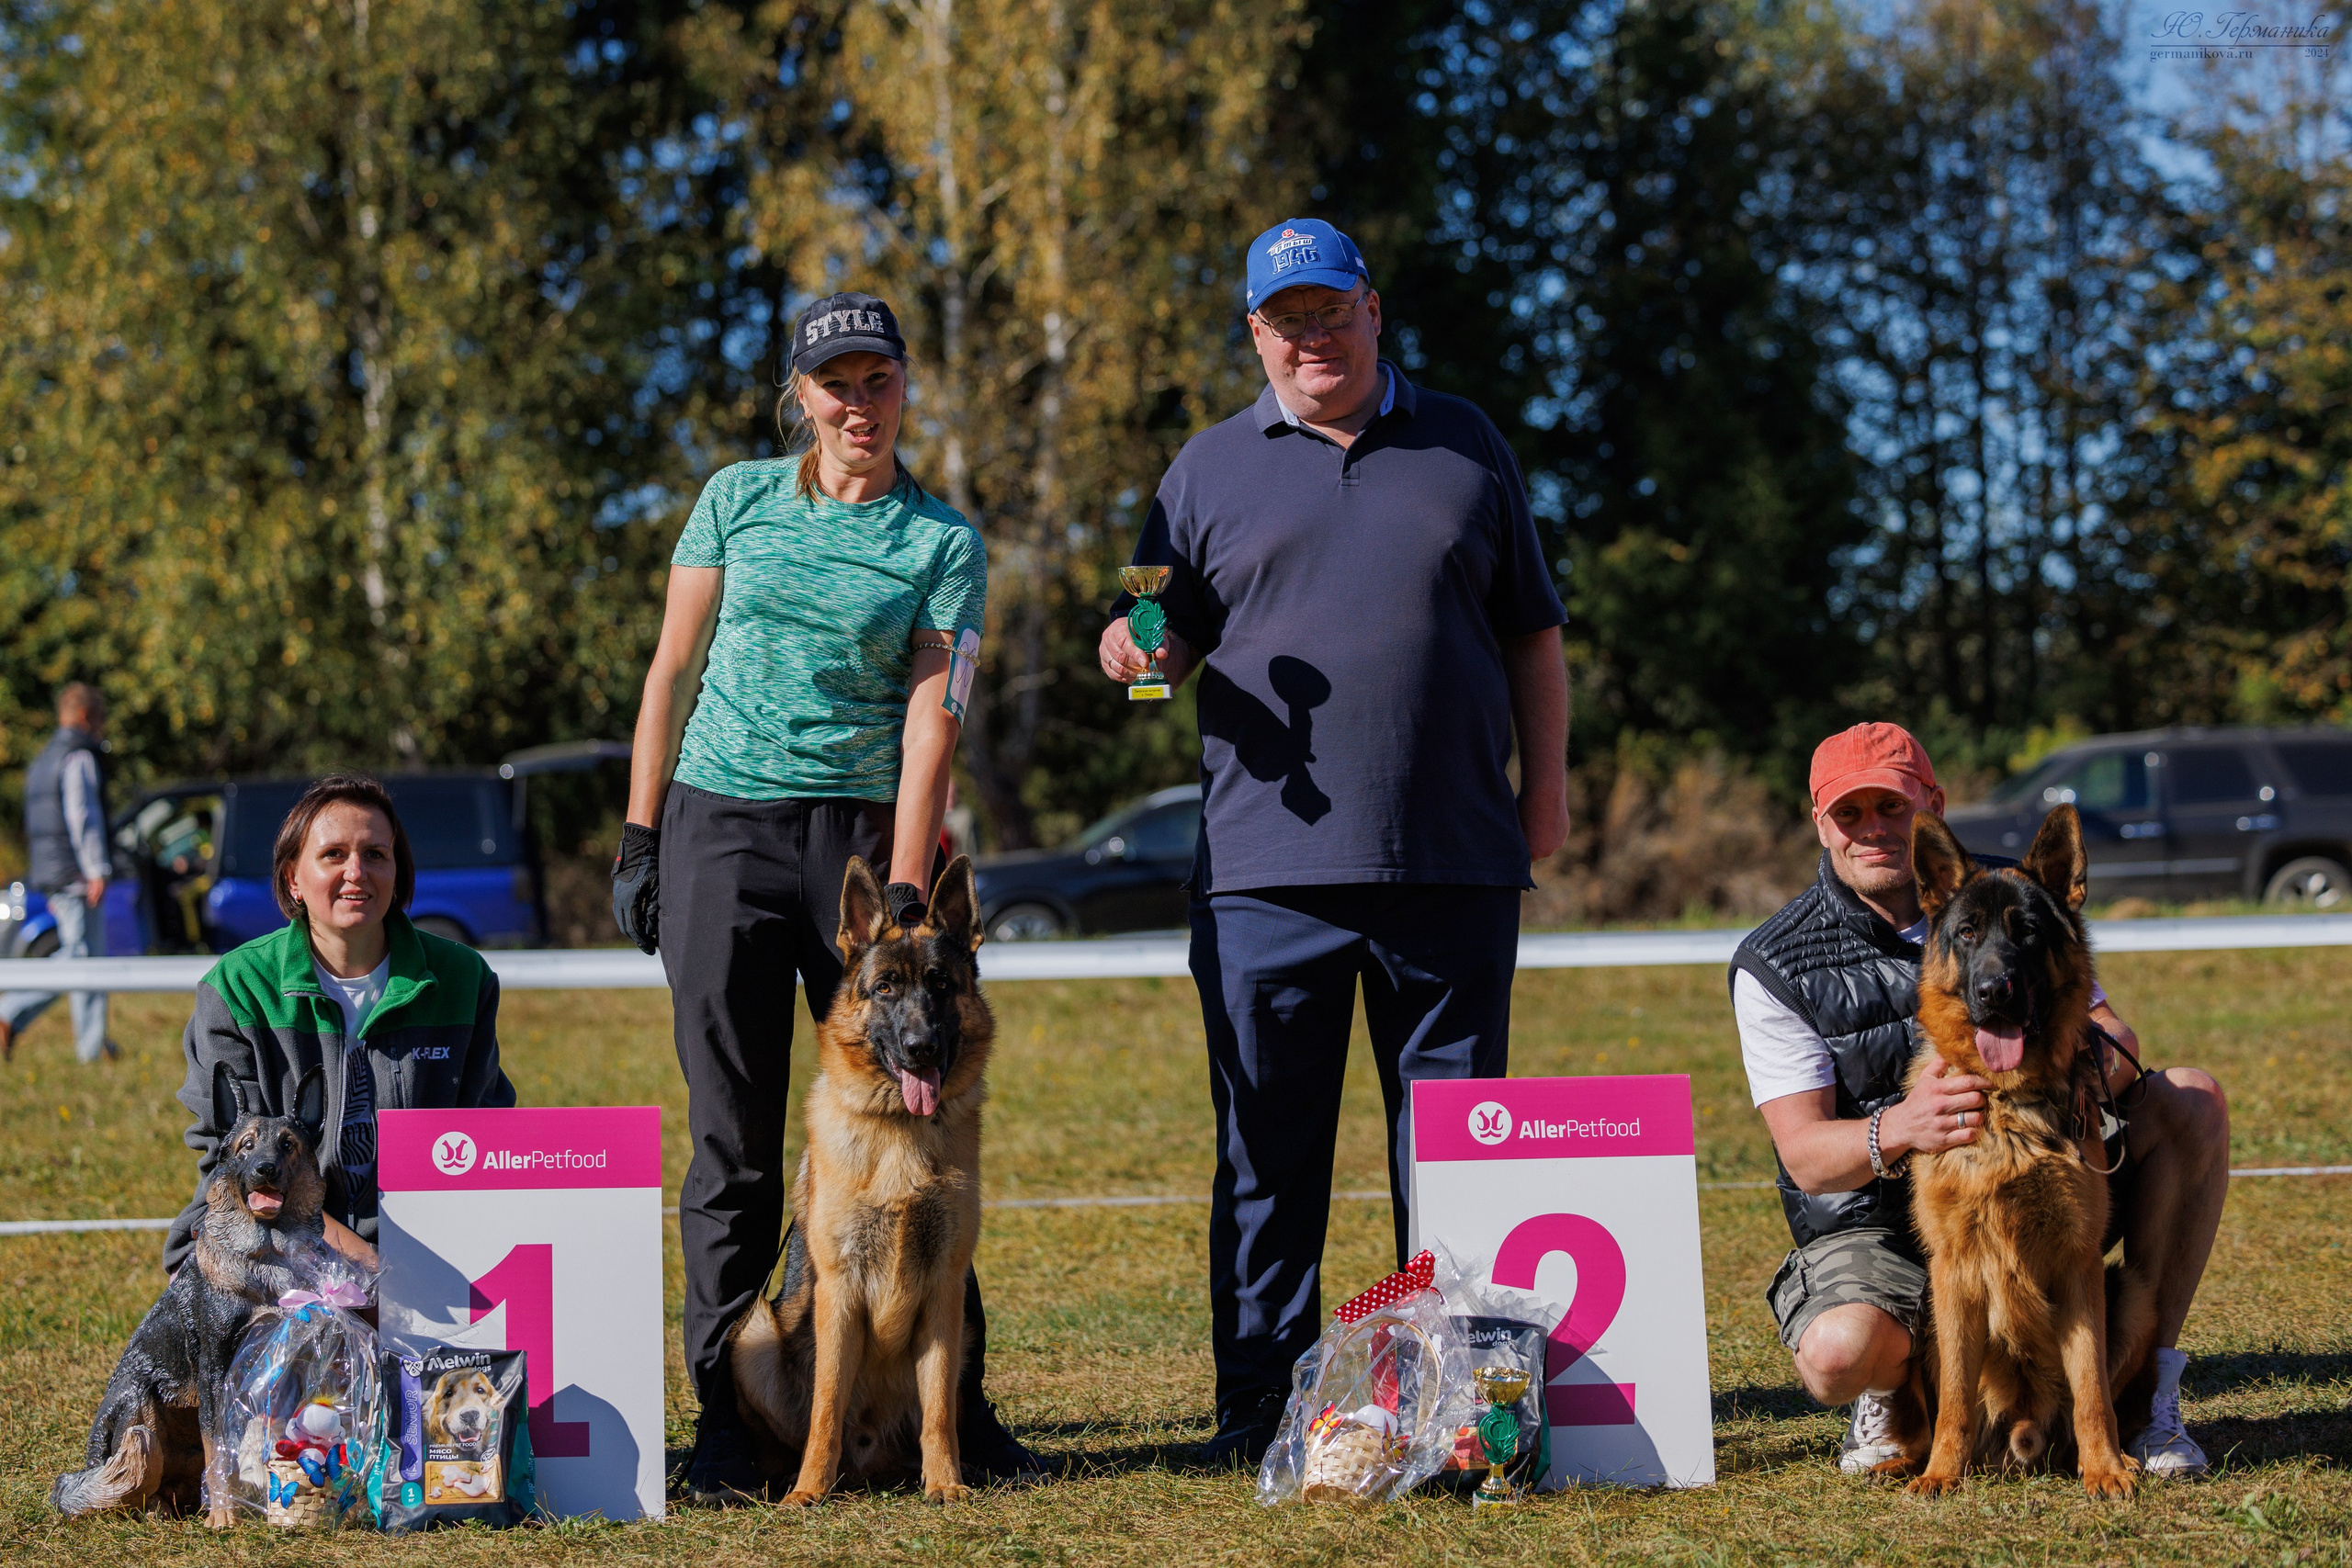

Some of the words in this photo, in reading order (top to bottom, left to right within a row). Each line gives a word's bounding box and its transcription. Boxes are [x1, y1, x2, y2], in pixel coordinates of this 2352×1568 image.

[1272, 246, 1321, 275] 1946
[805, 309, 885, 346] STYLE
[412, 1046, 450, 1060] K-FLEX
[1519, 1117, 1640, 1139] AllerPetfood
[482, 1149, 606, 1169] AllerPetfood
[1490, 1213, 1635, 1427] 2
[1467, 1326, 1512, 1344] elwin
[469, 1243, 590, 1458] 1
[427, 1352, 492, 1371] Melwin
[471, 1365, 492, 1373] dogs
[404, 1389, 419, 1446] SENIOR
[407, 1487, 415, 1497] 1
